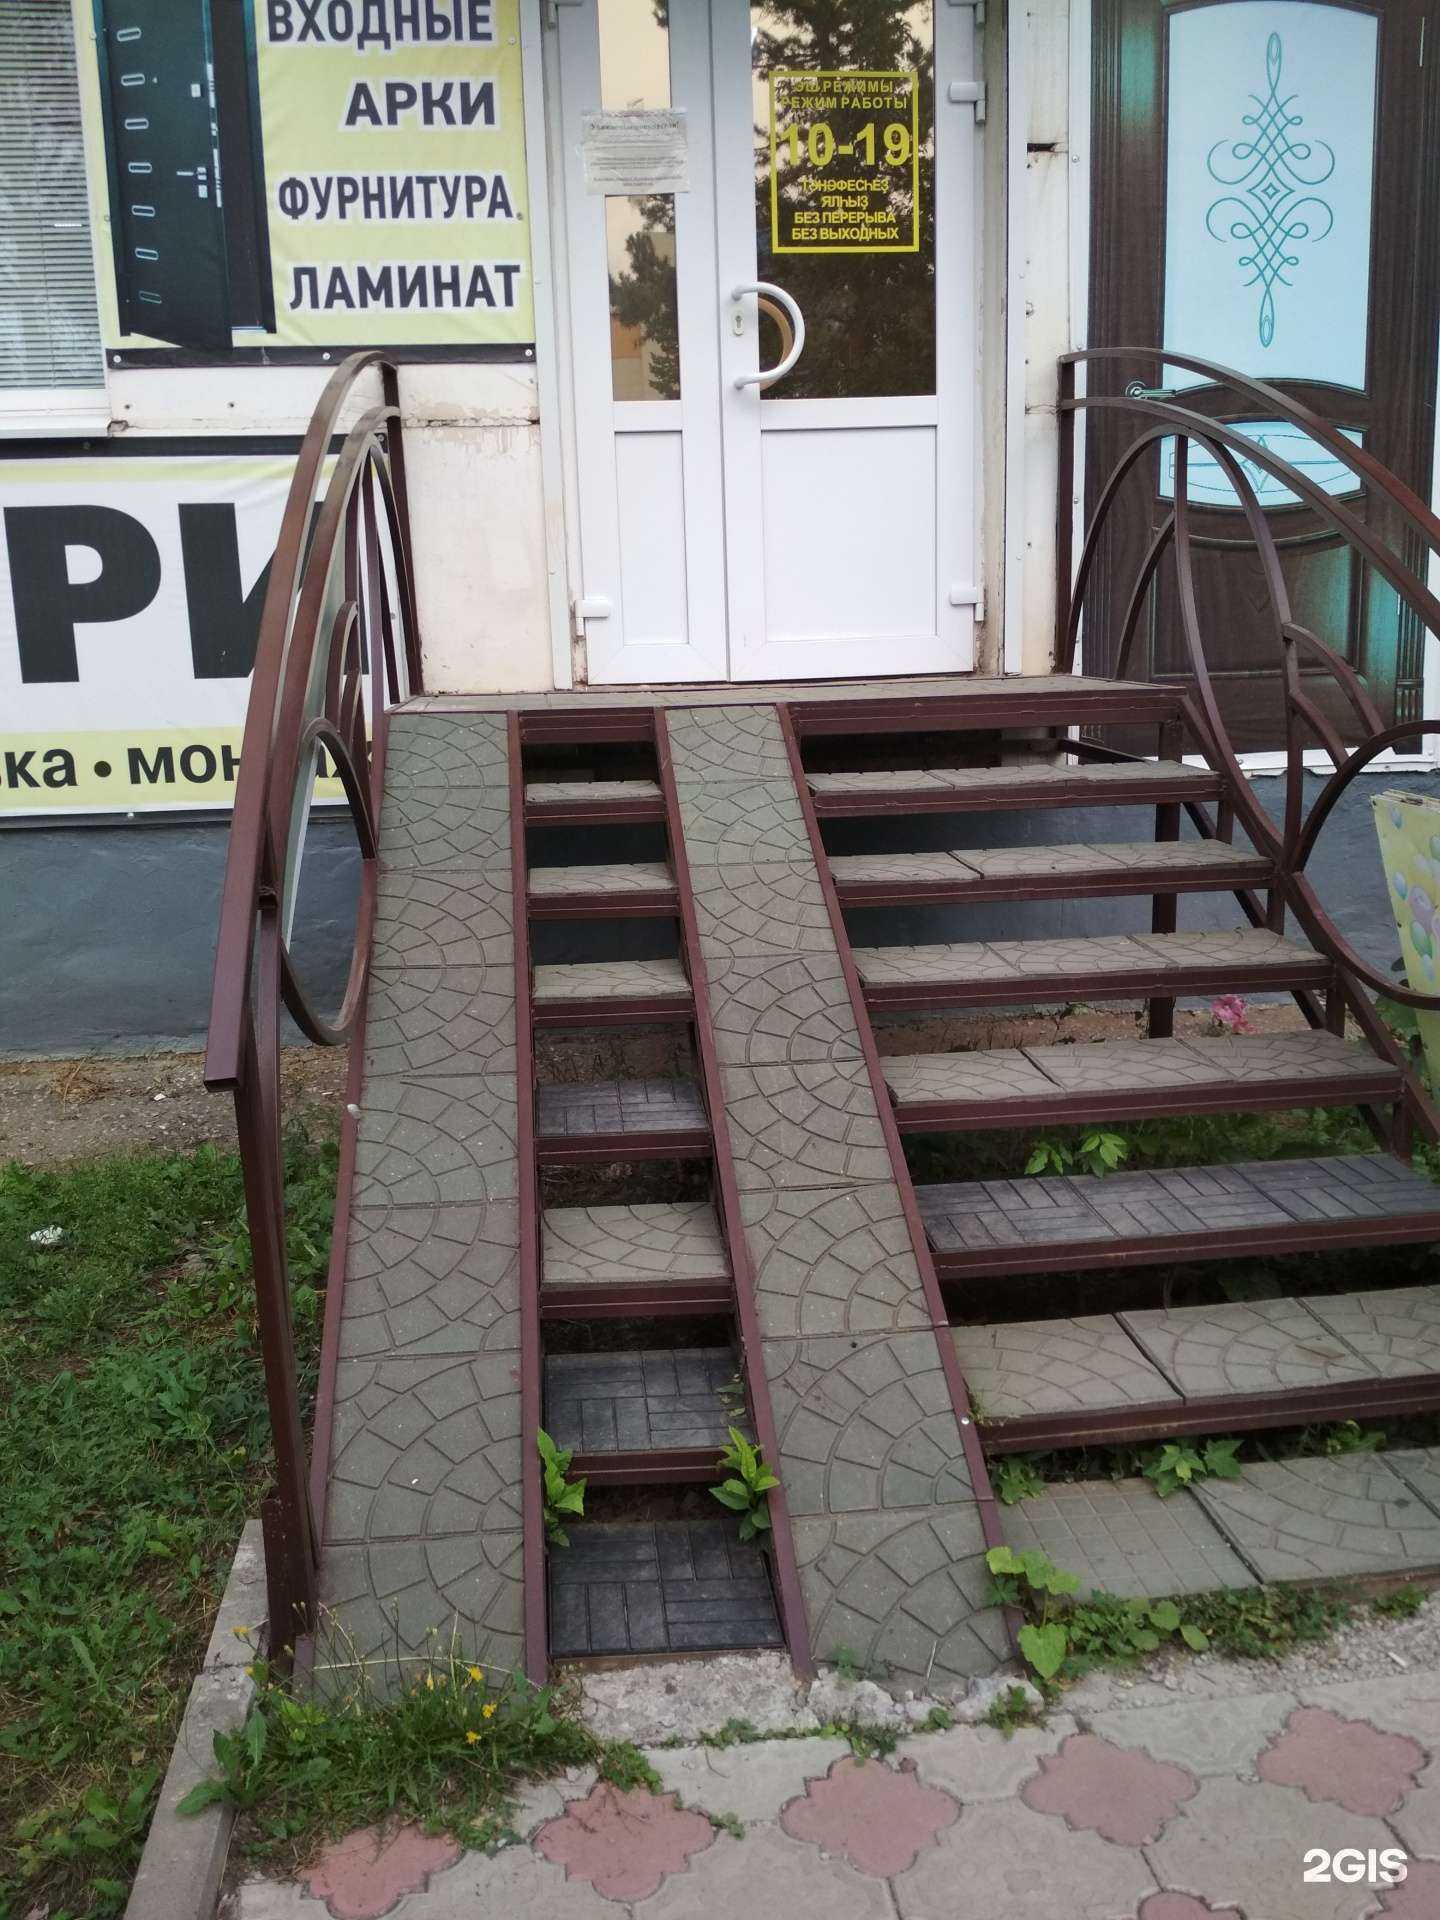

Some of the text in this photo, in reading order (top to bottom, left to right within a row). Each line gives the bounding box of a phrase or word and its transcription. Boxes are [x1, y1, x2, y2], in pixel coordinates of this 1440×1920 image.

[267, 0, 493, 50] ВХОДНЫЕ
[345, 81, 496, 127] АРКИ
[781, 97, 907, 109] РЕЖИМ РАБОТЫ
[823, 80, 893, 93] РЕЖИМЫ
[780, 122, 911, 167] 10-19
[279, 175, 513, 220] ФУРНИТУРА
[794, 212, 896, 224] БЕЗ ПЕРЕРЫВА
[792, 227, 899, 241] БЕЗ ВЫХОДНЫХ
[290, 265, 520, 310] ЛАМИНАТ
[0, 748, 79, 789] ка
